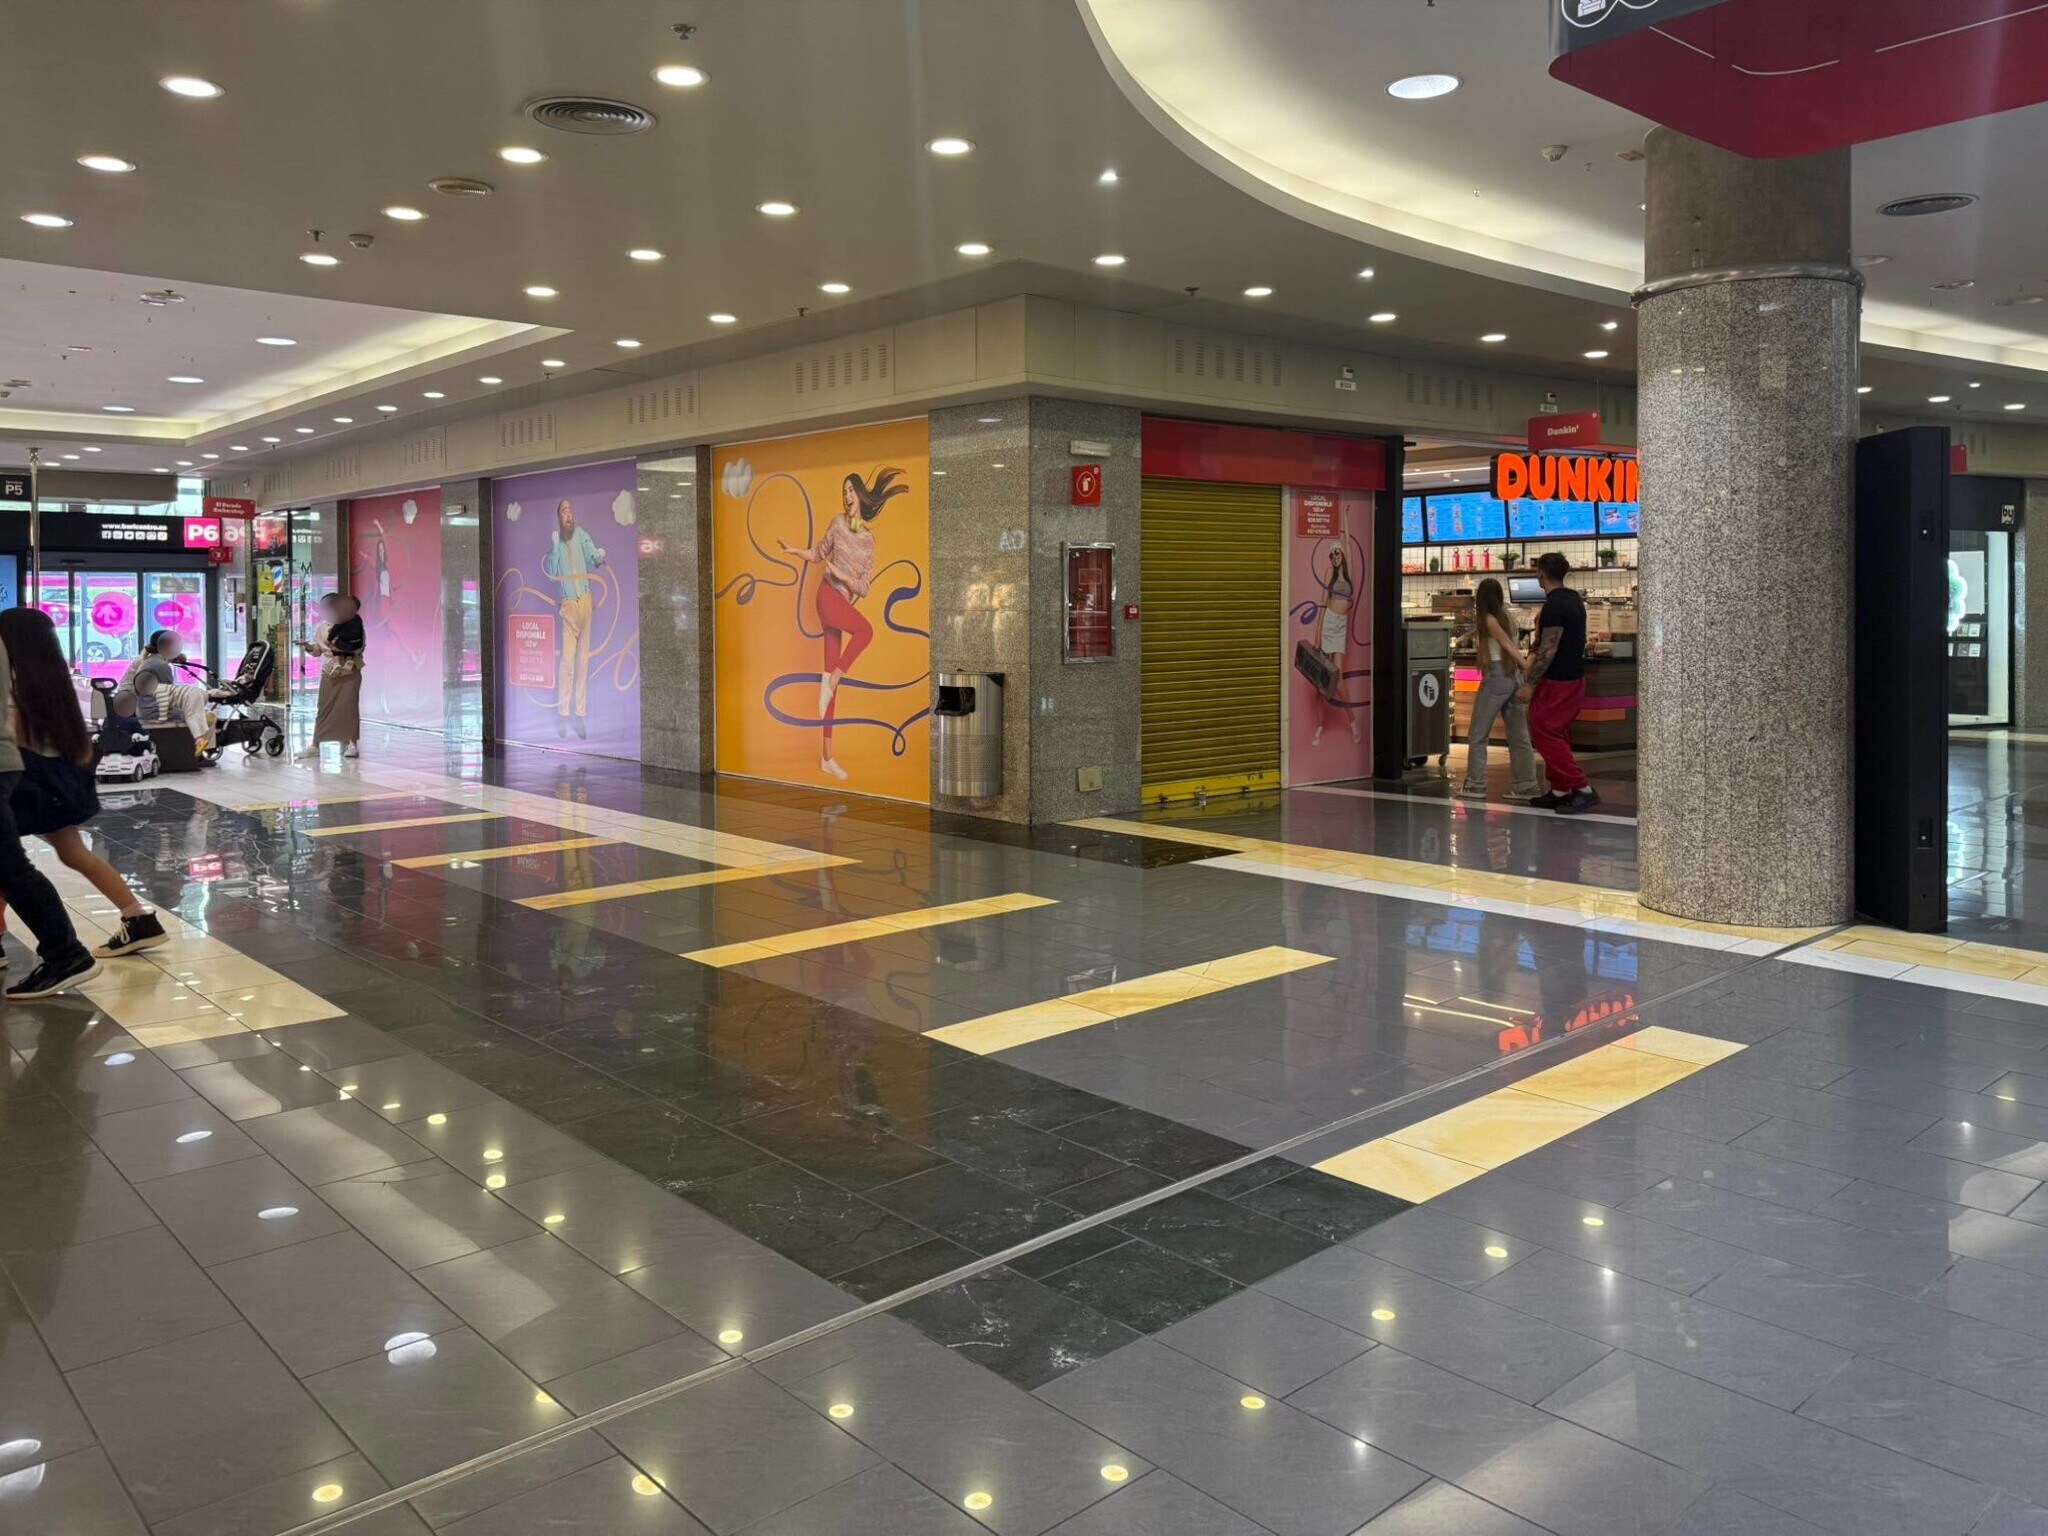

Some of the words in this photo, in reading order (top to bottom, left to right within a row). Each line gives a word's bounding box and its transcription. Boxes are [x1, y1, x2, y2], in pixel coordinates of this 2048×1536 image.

[1547, 425, 1579, 436] Dunkin'
[5, 484, 24, 496] P5
[188, 525, 219, 542] P6
[522, 622, 539, 630] LOCAL
[516, 630, 546, 639] DISPONIBLE
